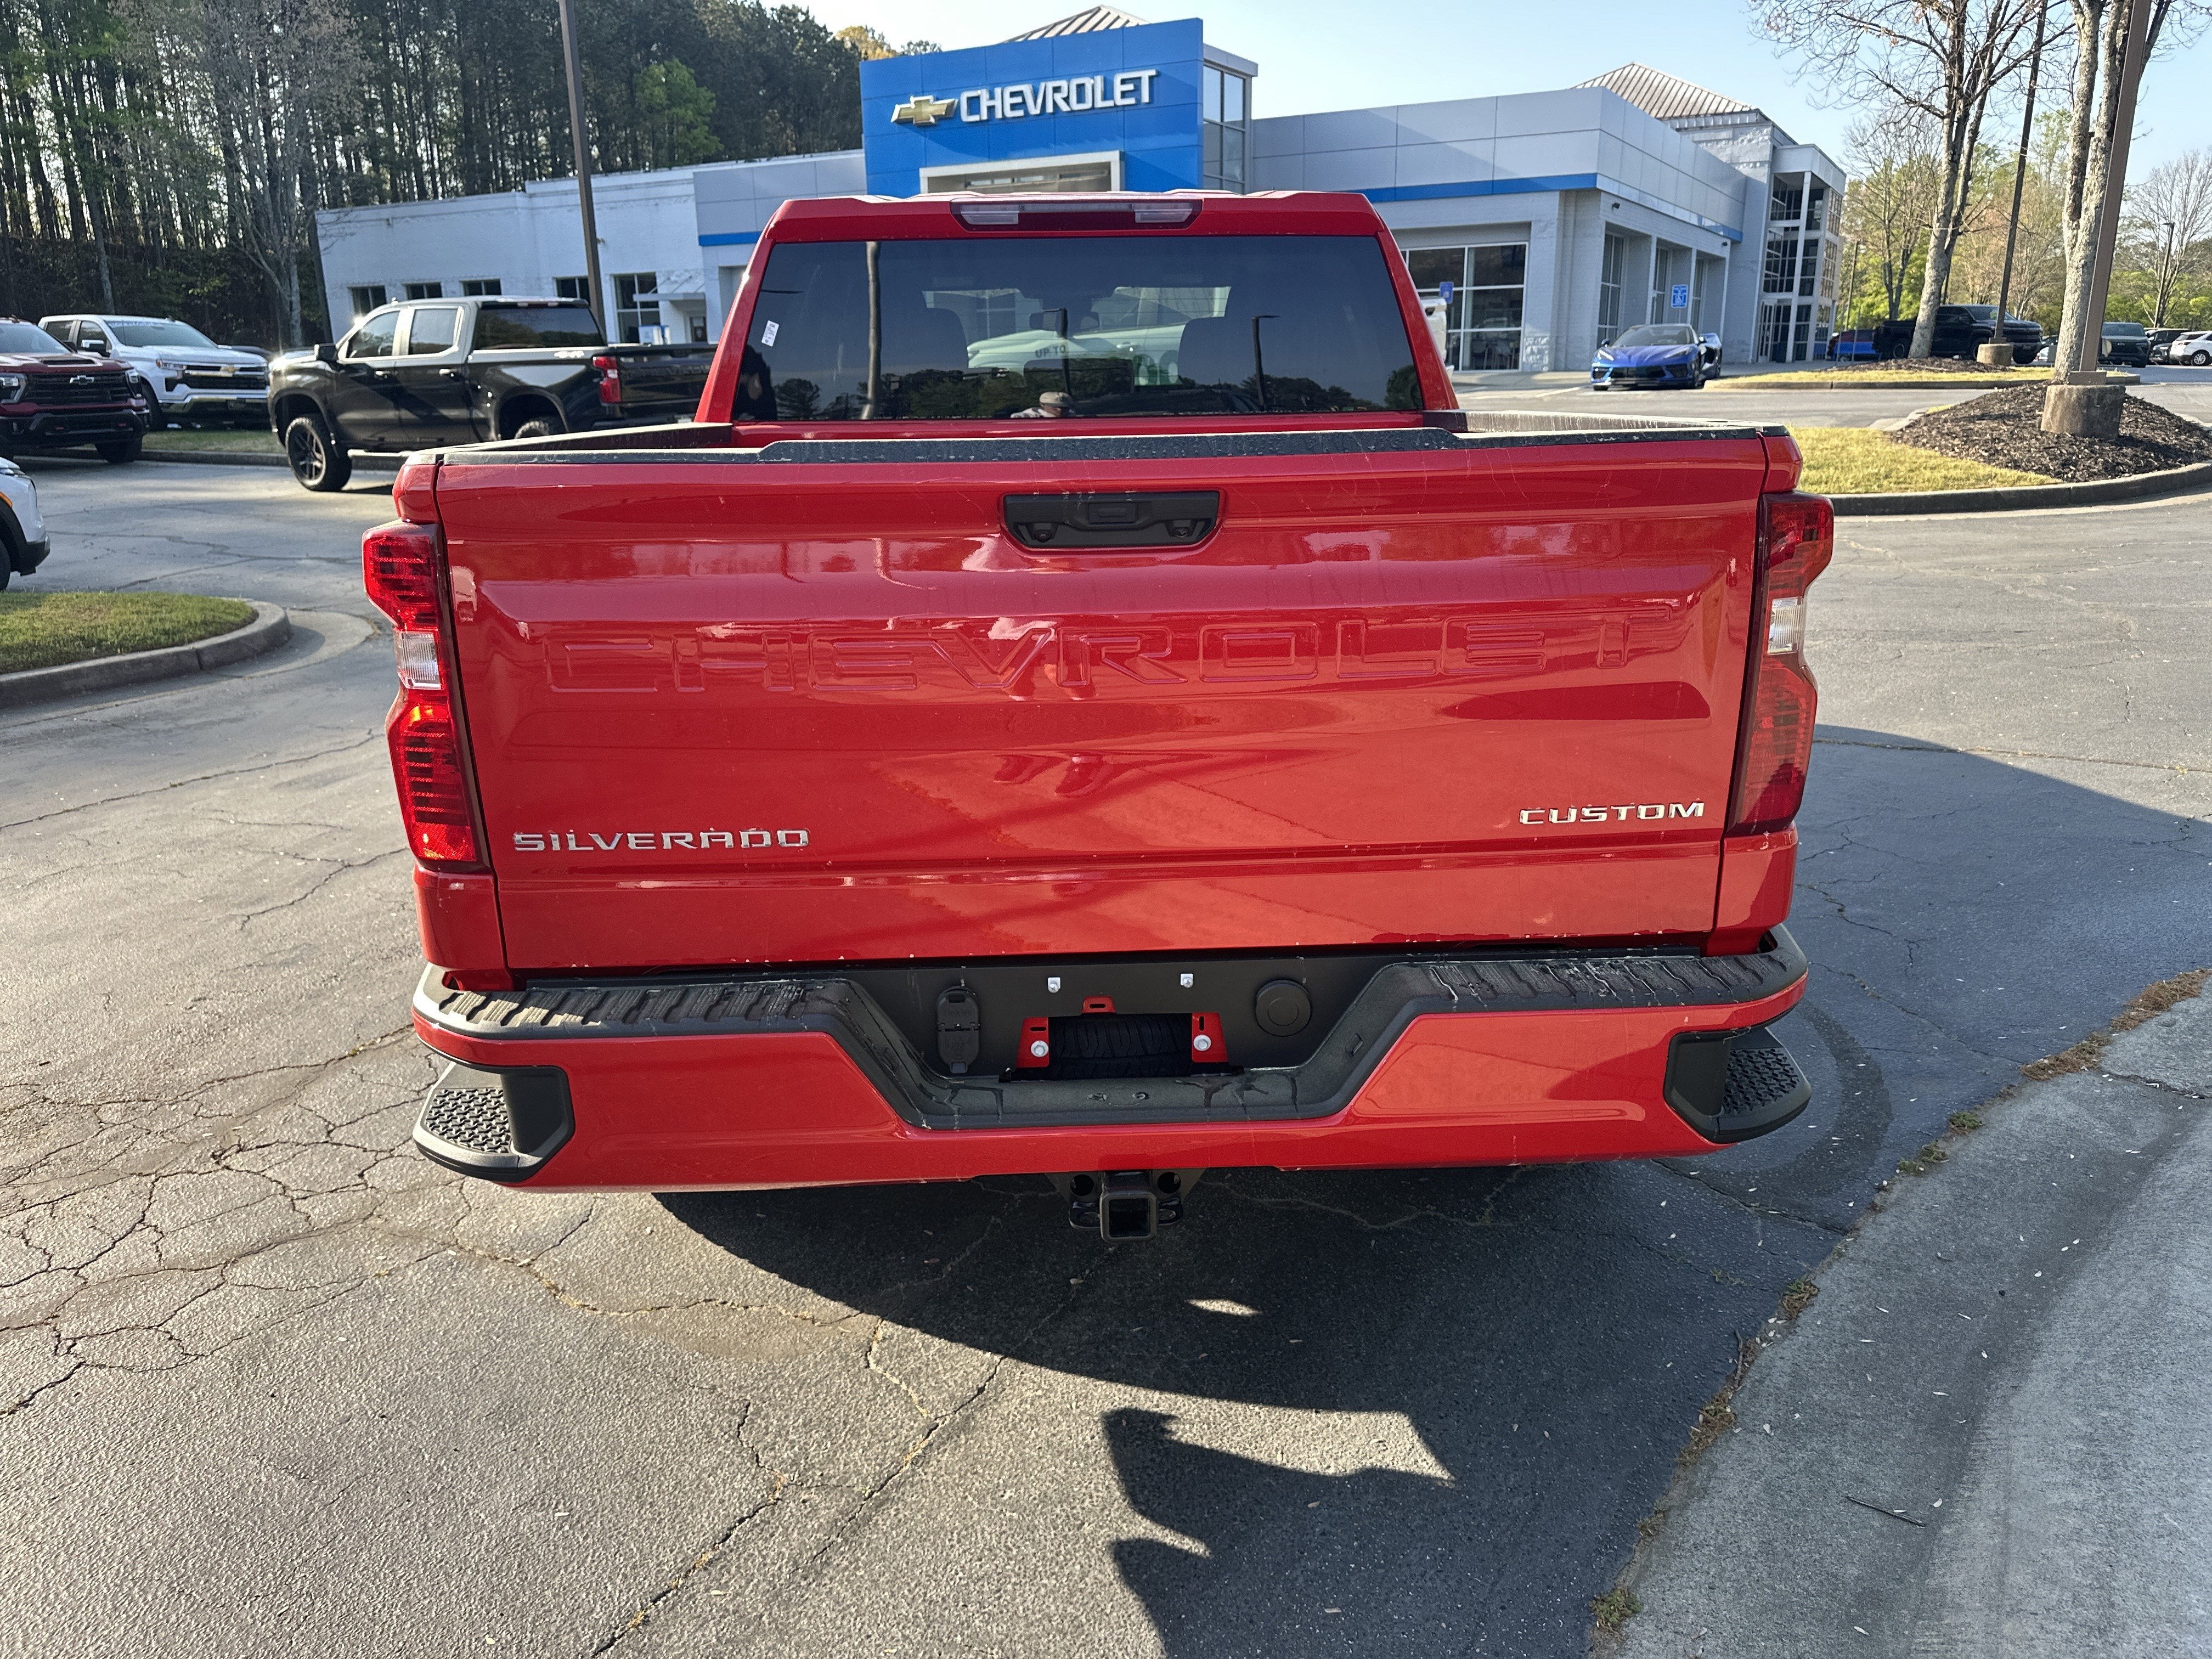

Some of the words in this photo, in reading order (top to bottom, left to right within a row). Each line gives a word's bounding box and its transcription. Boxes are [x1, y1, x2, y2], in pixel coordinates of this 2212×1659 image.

[960, 69, 1158, 123] CHEVROLET
[1035, 347, 1050, 358] UP
[542, 605, 1672, 693] CHEVROLET
[1519, 801, 1705, 825] CUSTOM
[515, 829, 810, 851] SILVERADO
